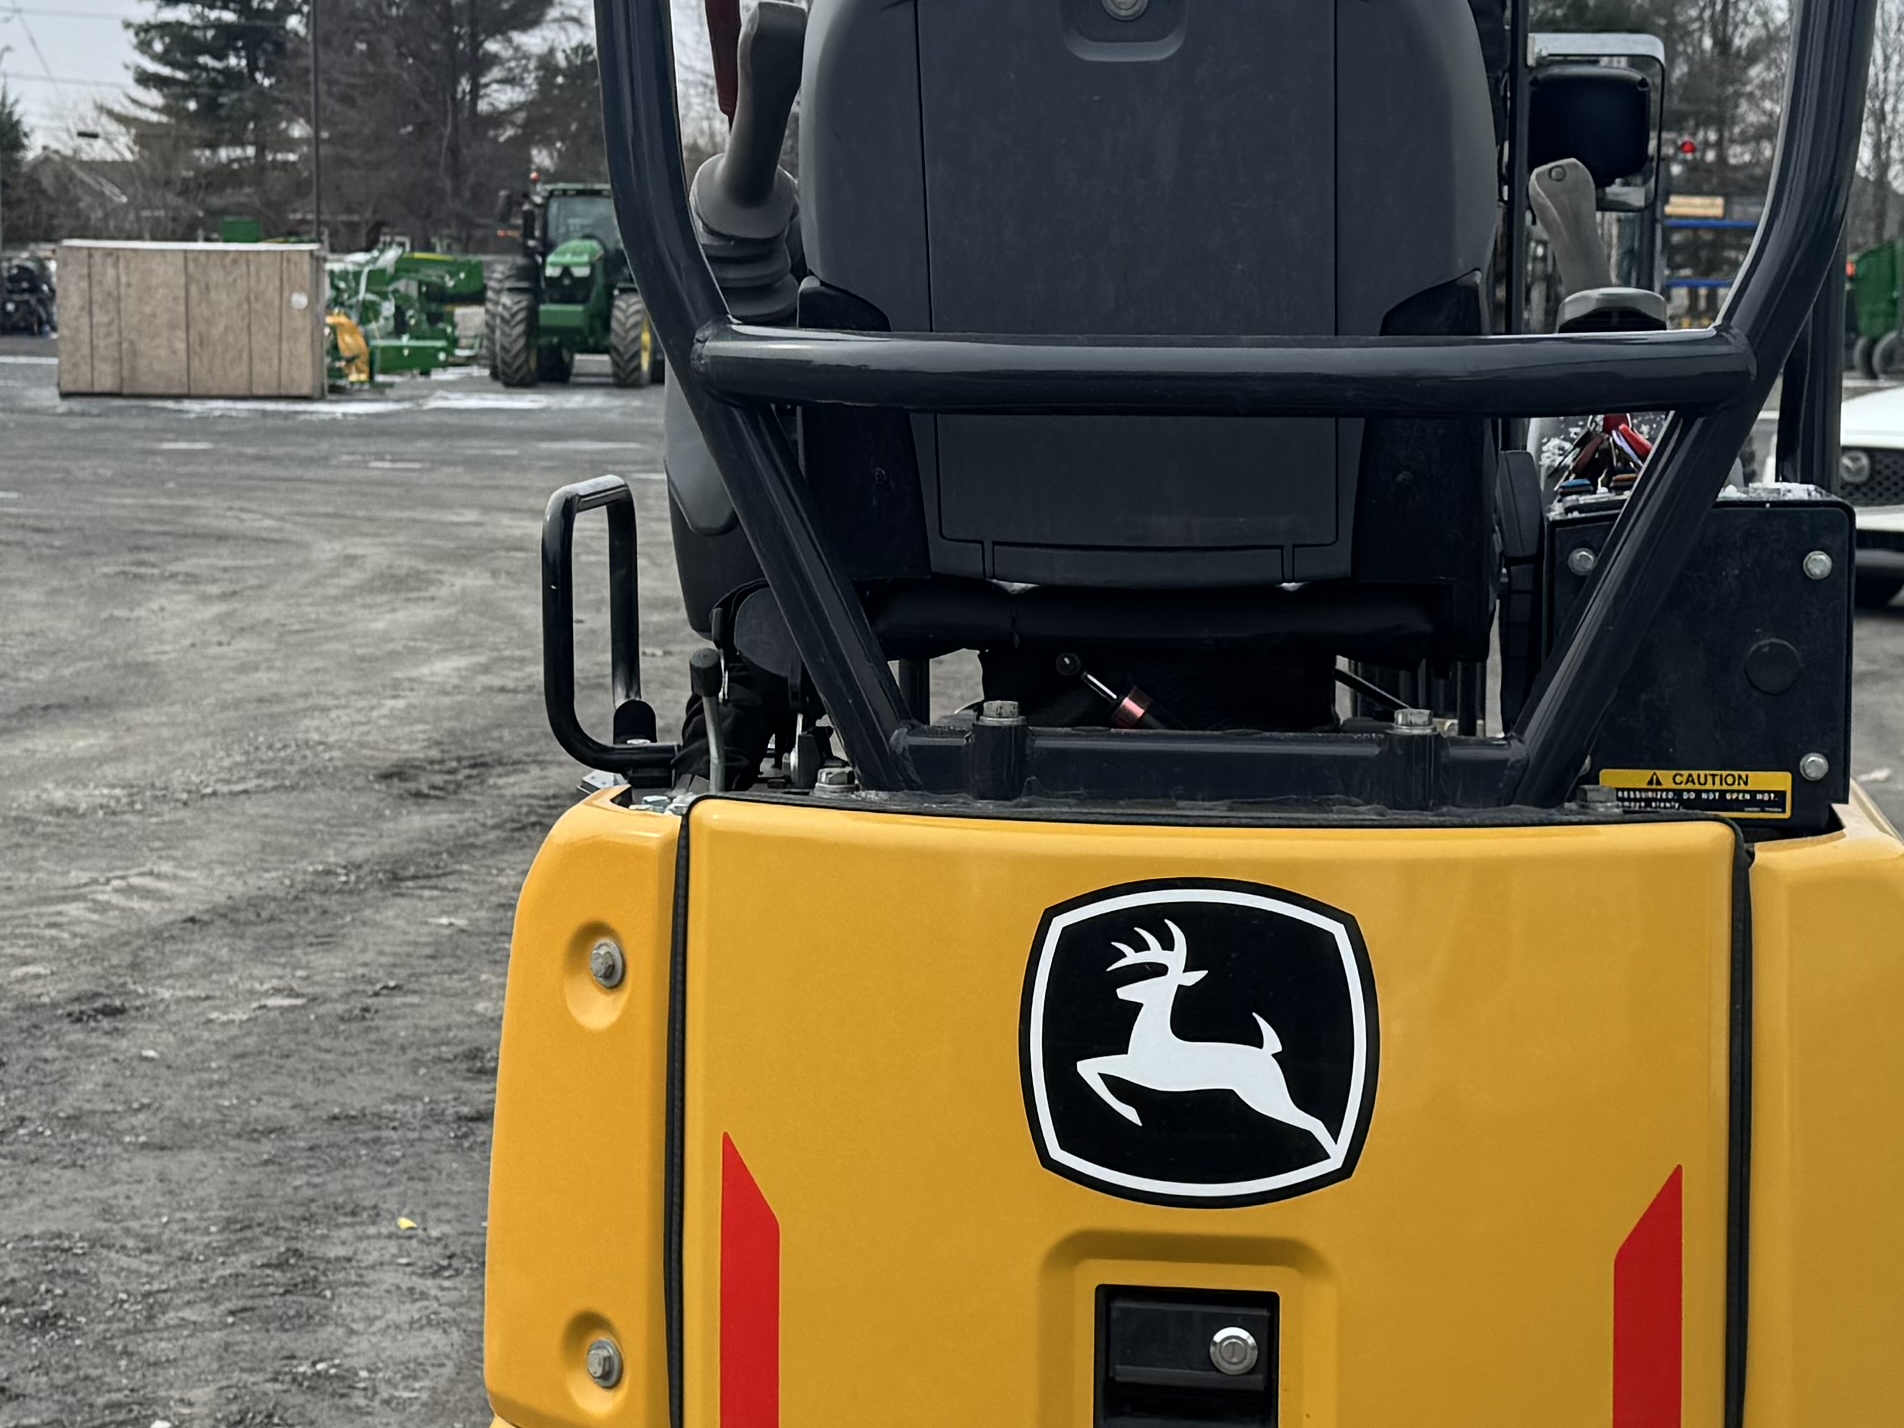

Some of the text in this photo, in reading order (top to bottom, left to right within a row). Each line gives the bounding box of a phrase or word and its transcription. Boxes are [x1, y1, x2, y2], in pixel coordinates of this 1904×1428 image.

[1672, 773, 1749, 787] CAUTION
[1617, 790, 1677, 799] RESSURIZED.
[1701, 791, 1719, 800] NOT
[1725, 792, 1751, 801] OPEN
